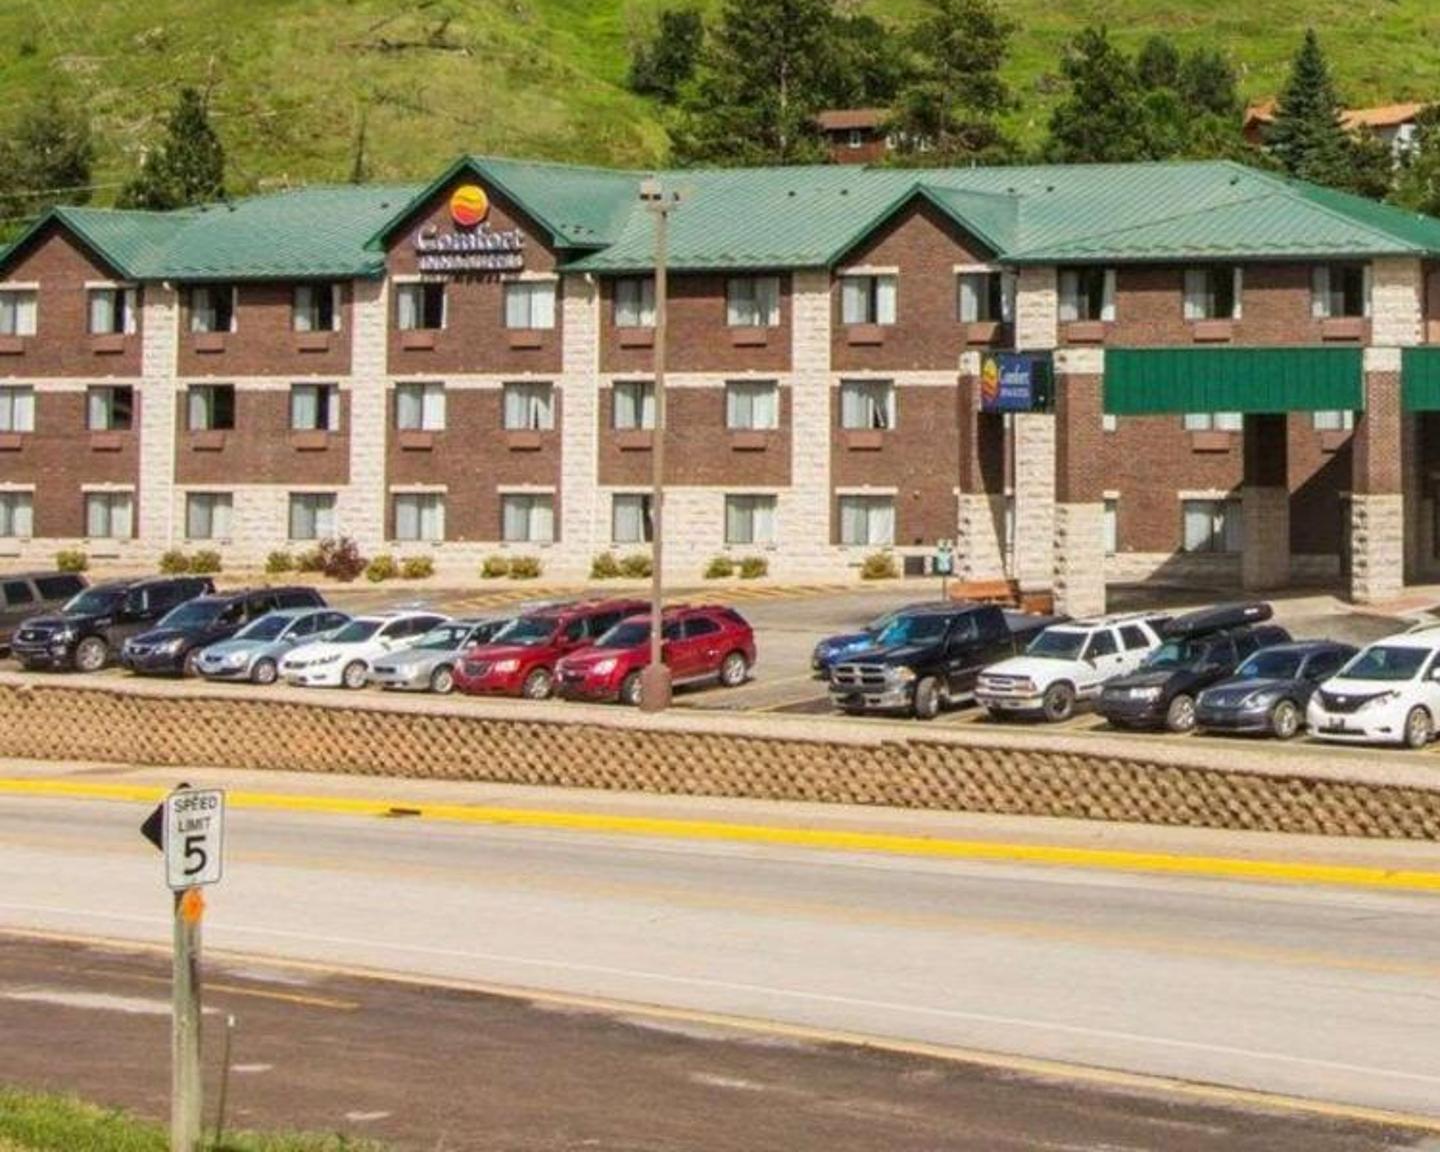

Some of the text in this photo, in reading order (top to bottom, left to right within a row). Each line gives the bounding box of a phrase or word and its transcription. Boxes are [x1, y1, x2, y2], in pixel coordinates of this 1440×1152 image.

[418, 222, 524, 250] Comfort
[174, 796, 217, 813] SPEED
[178, 816, 211, 833] LIMIT
[184, 835, 207, 876] 5
